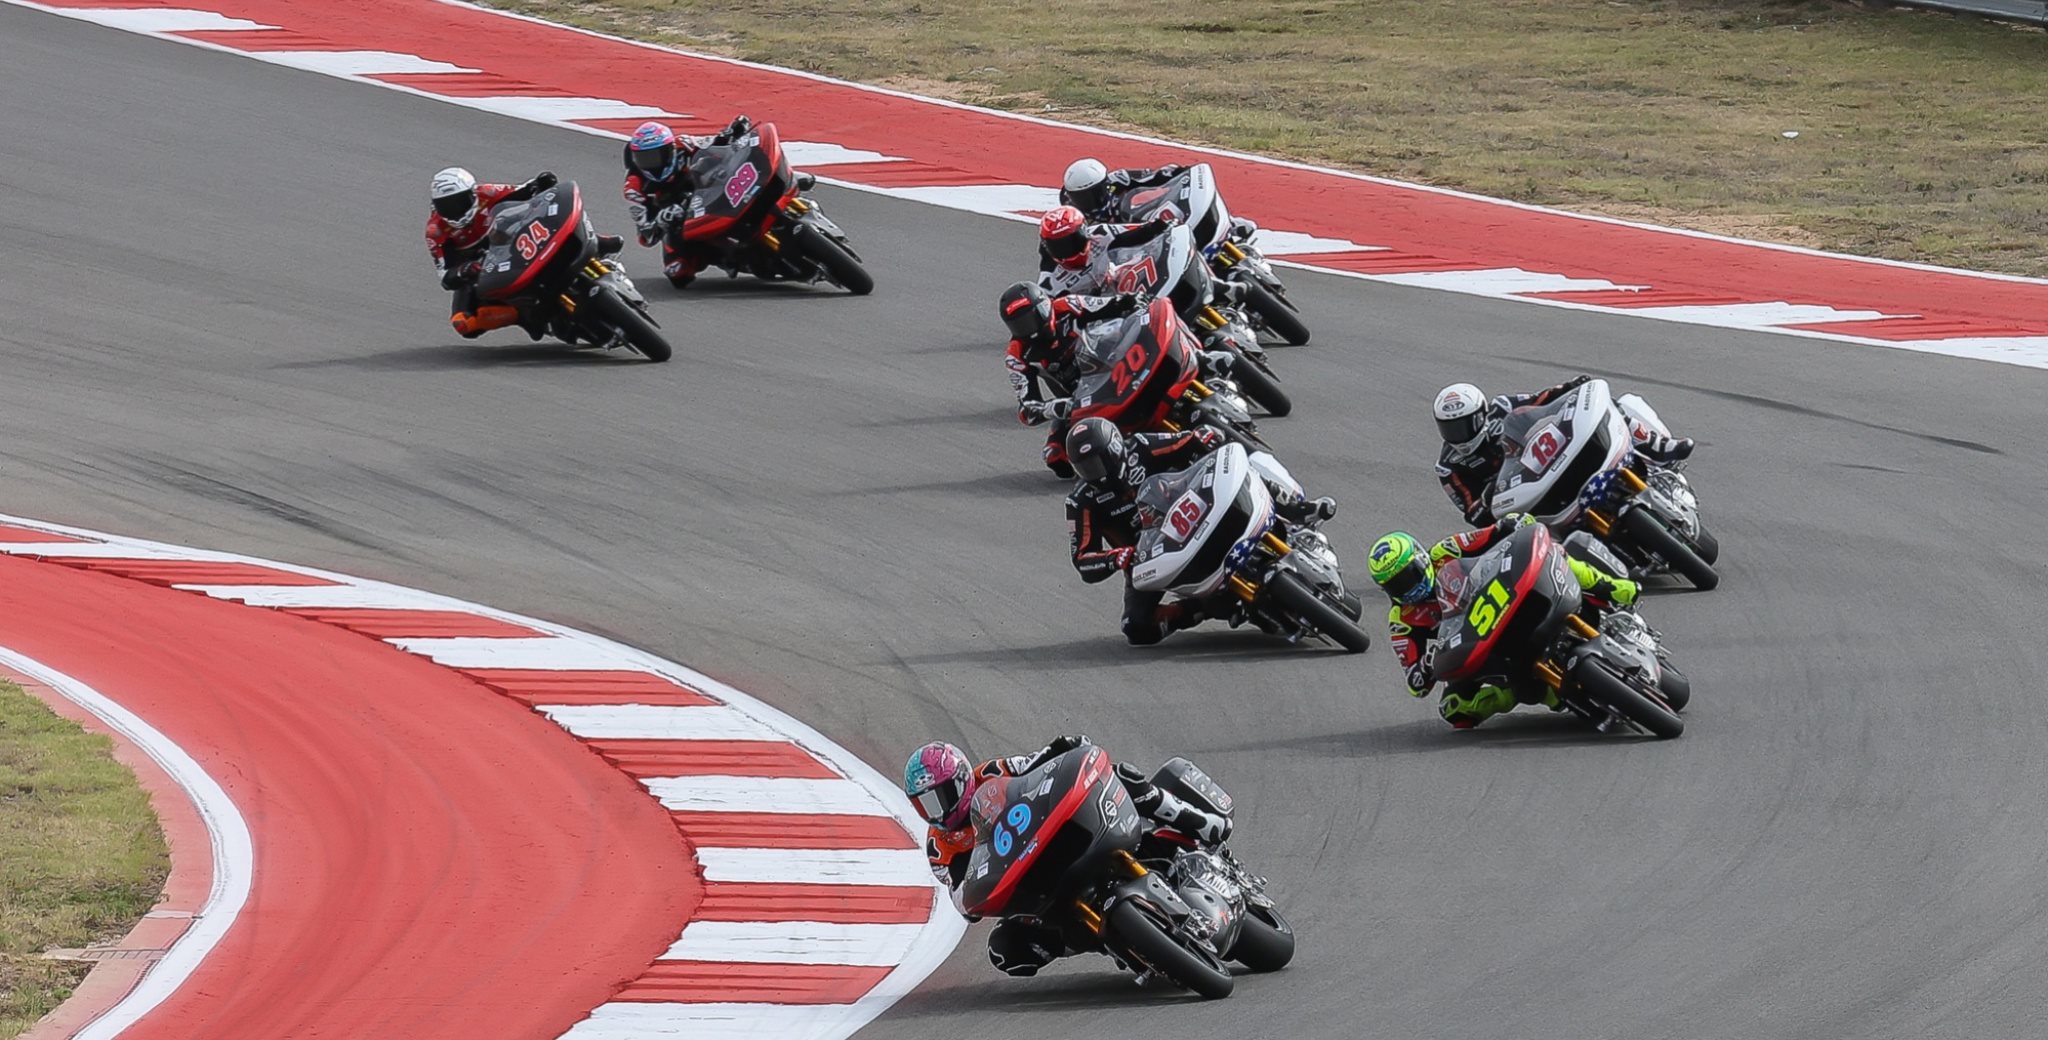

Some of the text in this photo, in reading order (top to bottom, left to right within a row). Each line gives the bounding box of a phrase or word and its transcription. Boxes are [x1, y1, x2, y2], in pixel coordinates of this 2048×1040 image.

[516, 220, 550, 260] 34
[1111, 343, 1146, 397] 20
[1531, 432, 1558, 466] 13
[1170, 497, 1200, 537] 85
[1468, 578, 1510, 637] 51
[994, 803, 1031, 856] 69
